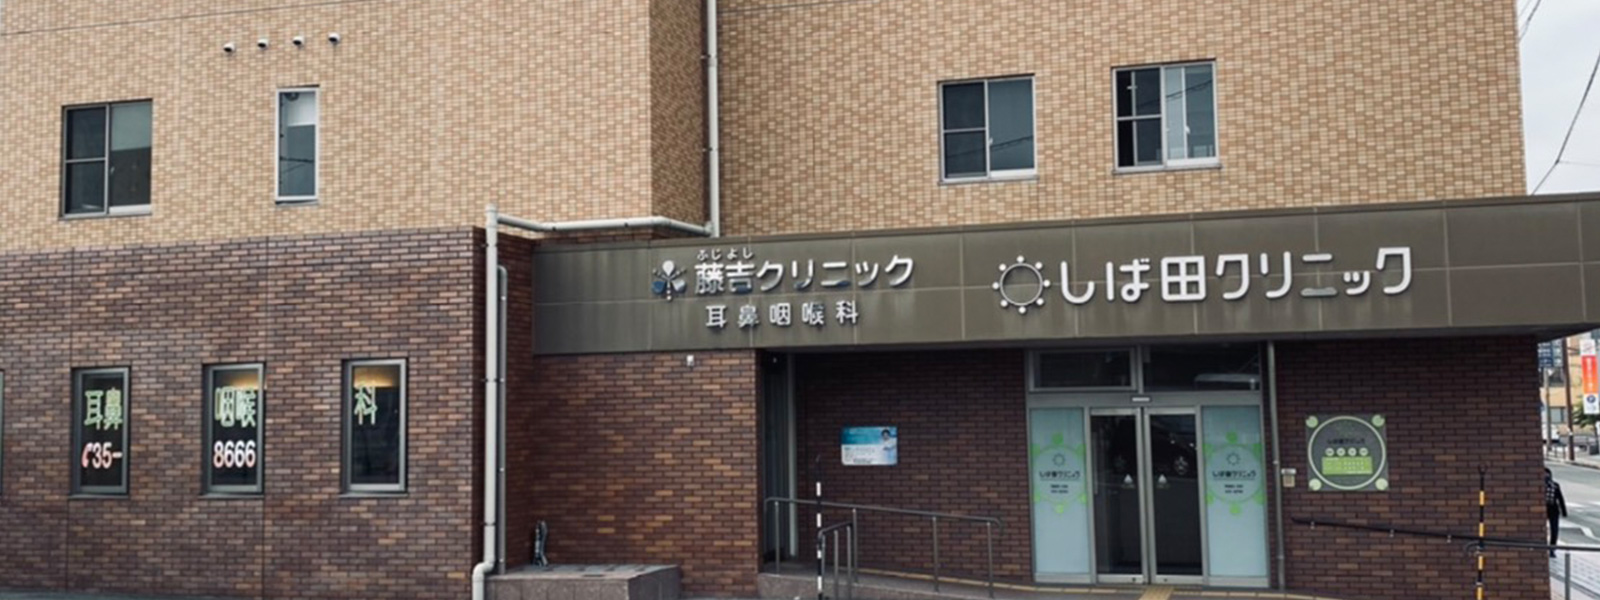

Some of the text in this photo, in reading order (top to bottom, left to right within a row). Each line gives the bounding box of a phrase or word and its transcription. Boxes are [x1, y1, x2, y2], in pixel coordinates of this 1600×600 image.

[696, 247, 753, 260] ふじよし
[694, 254, 914, 295] 藤吉クリニック
[1060, 246, 1412, 304] しば田クリニック
[705, 300, 859, 328] 耳鼻咽喉科
[84, 382, 378, 430] 耳鼻 咽喉 科
[213, 440, 256, 468] 8666
